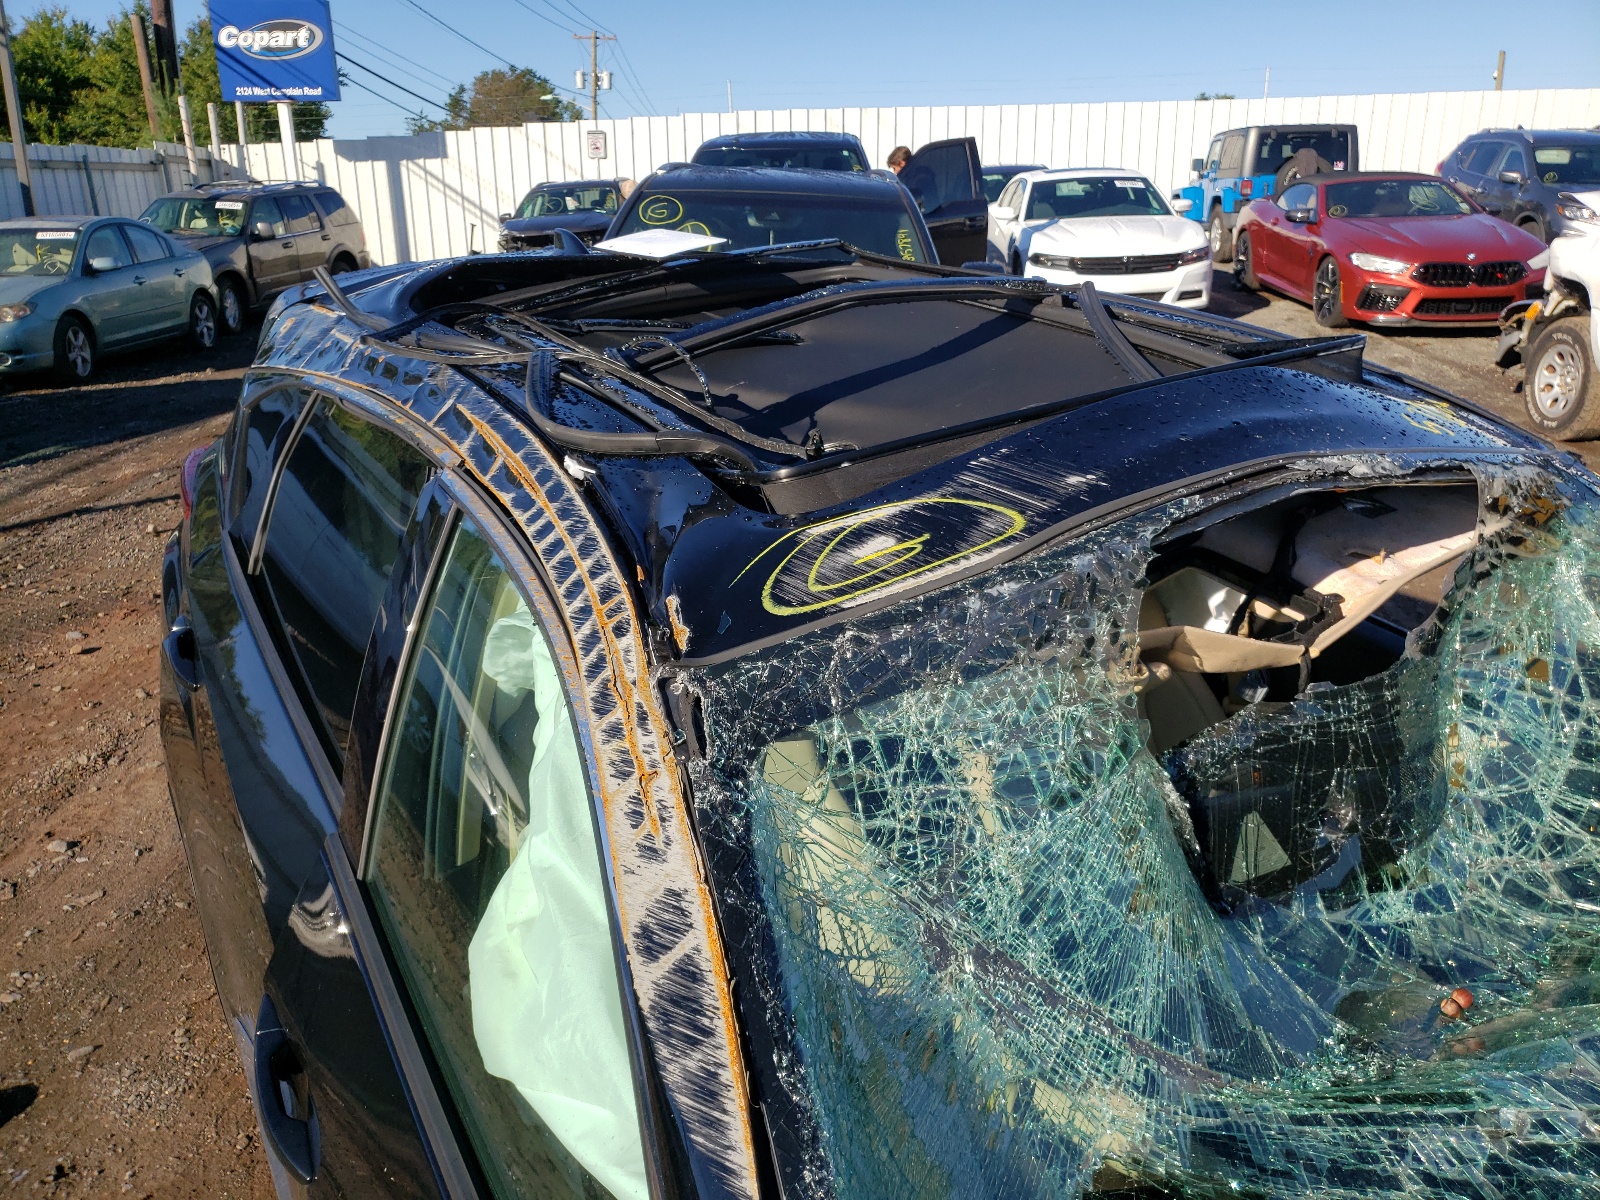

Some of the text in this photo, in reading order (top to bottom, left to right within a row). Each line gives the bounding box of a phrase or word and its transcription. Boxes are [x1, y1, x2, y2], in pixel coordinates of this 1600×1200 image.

[218, 26, 310, 52] Copart
[236, 87, 251, 96] 2124
[252, 87, 270, 96] West
[303, 87, 322, 96] Road
